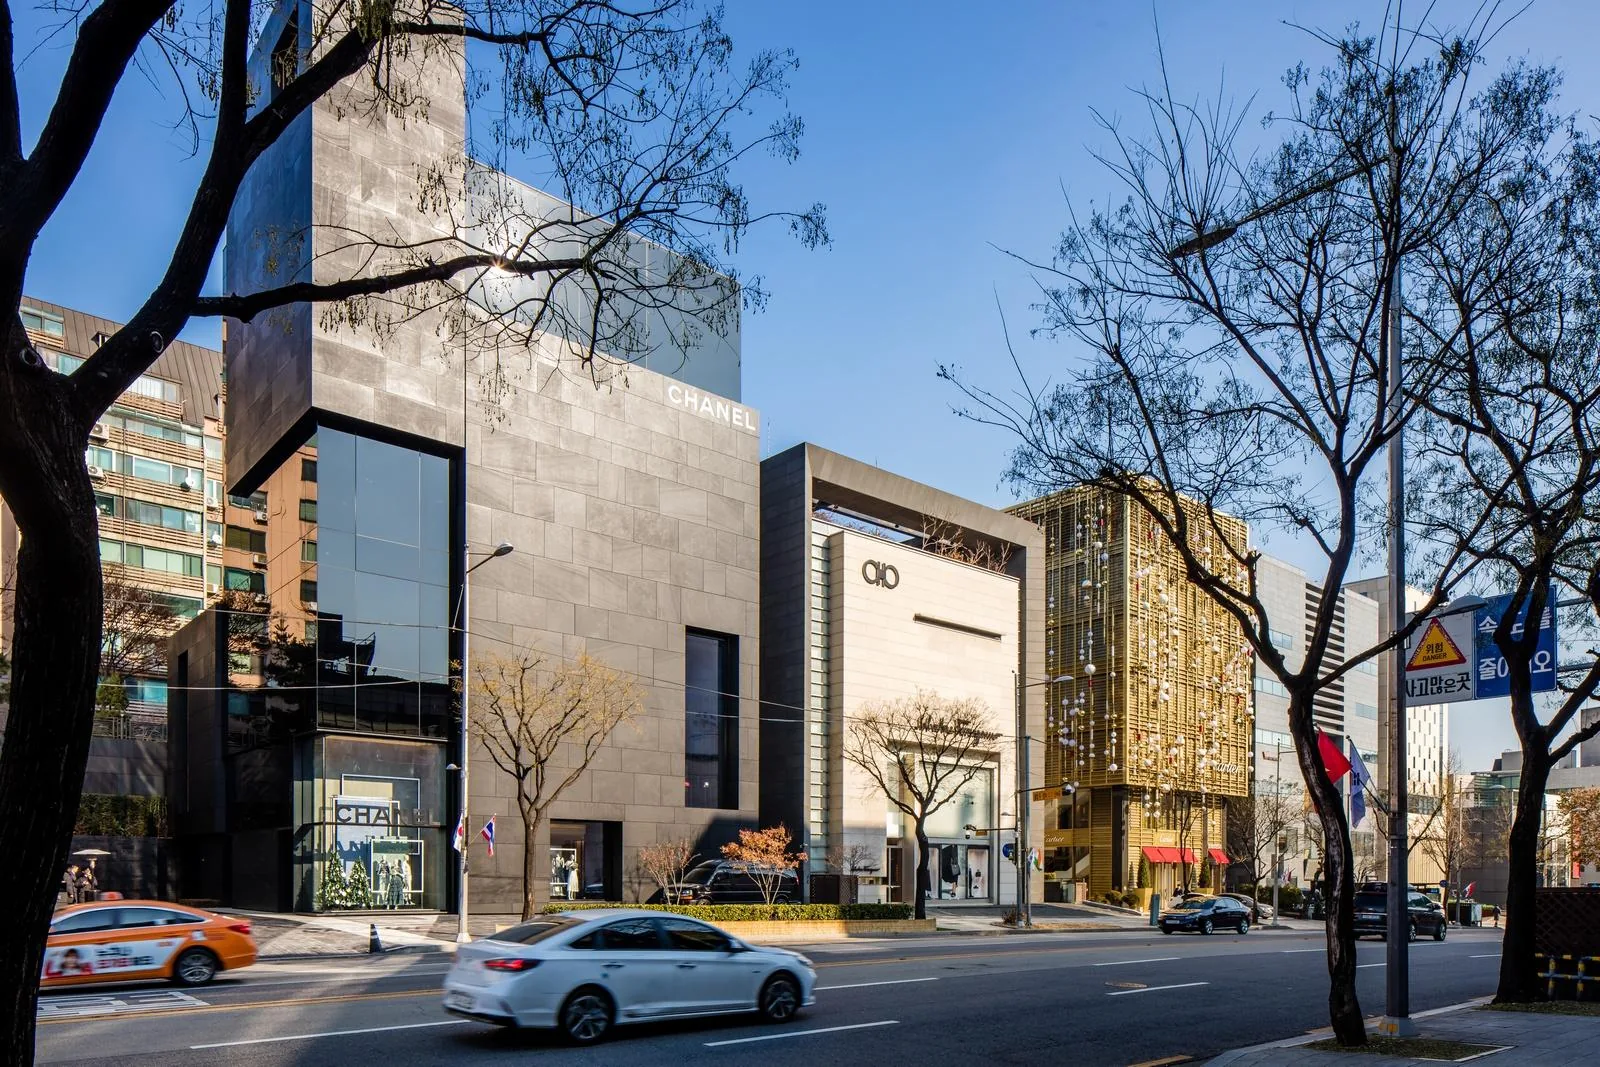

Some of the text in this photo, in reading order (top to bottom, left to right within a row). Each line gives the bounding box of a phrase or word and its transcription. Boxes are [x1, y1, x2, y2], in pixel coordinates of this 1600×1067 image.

[667, 385, 756, 431] CHANEL
[1426, 642, 1444, 654] 위험
[1422, 652, 1448, 662] DANGER
